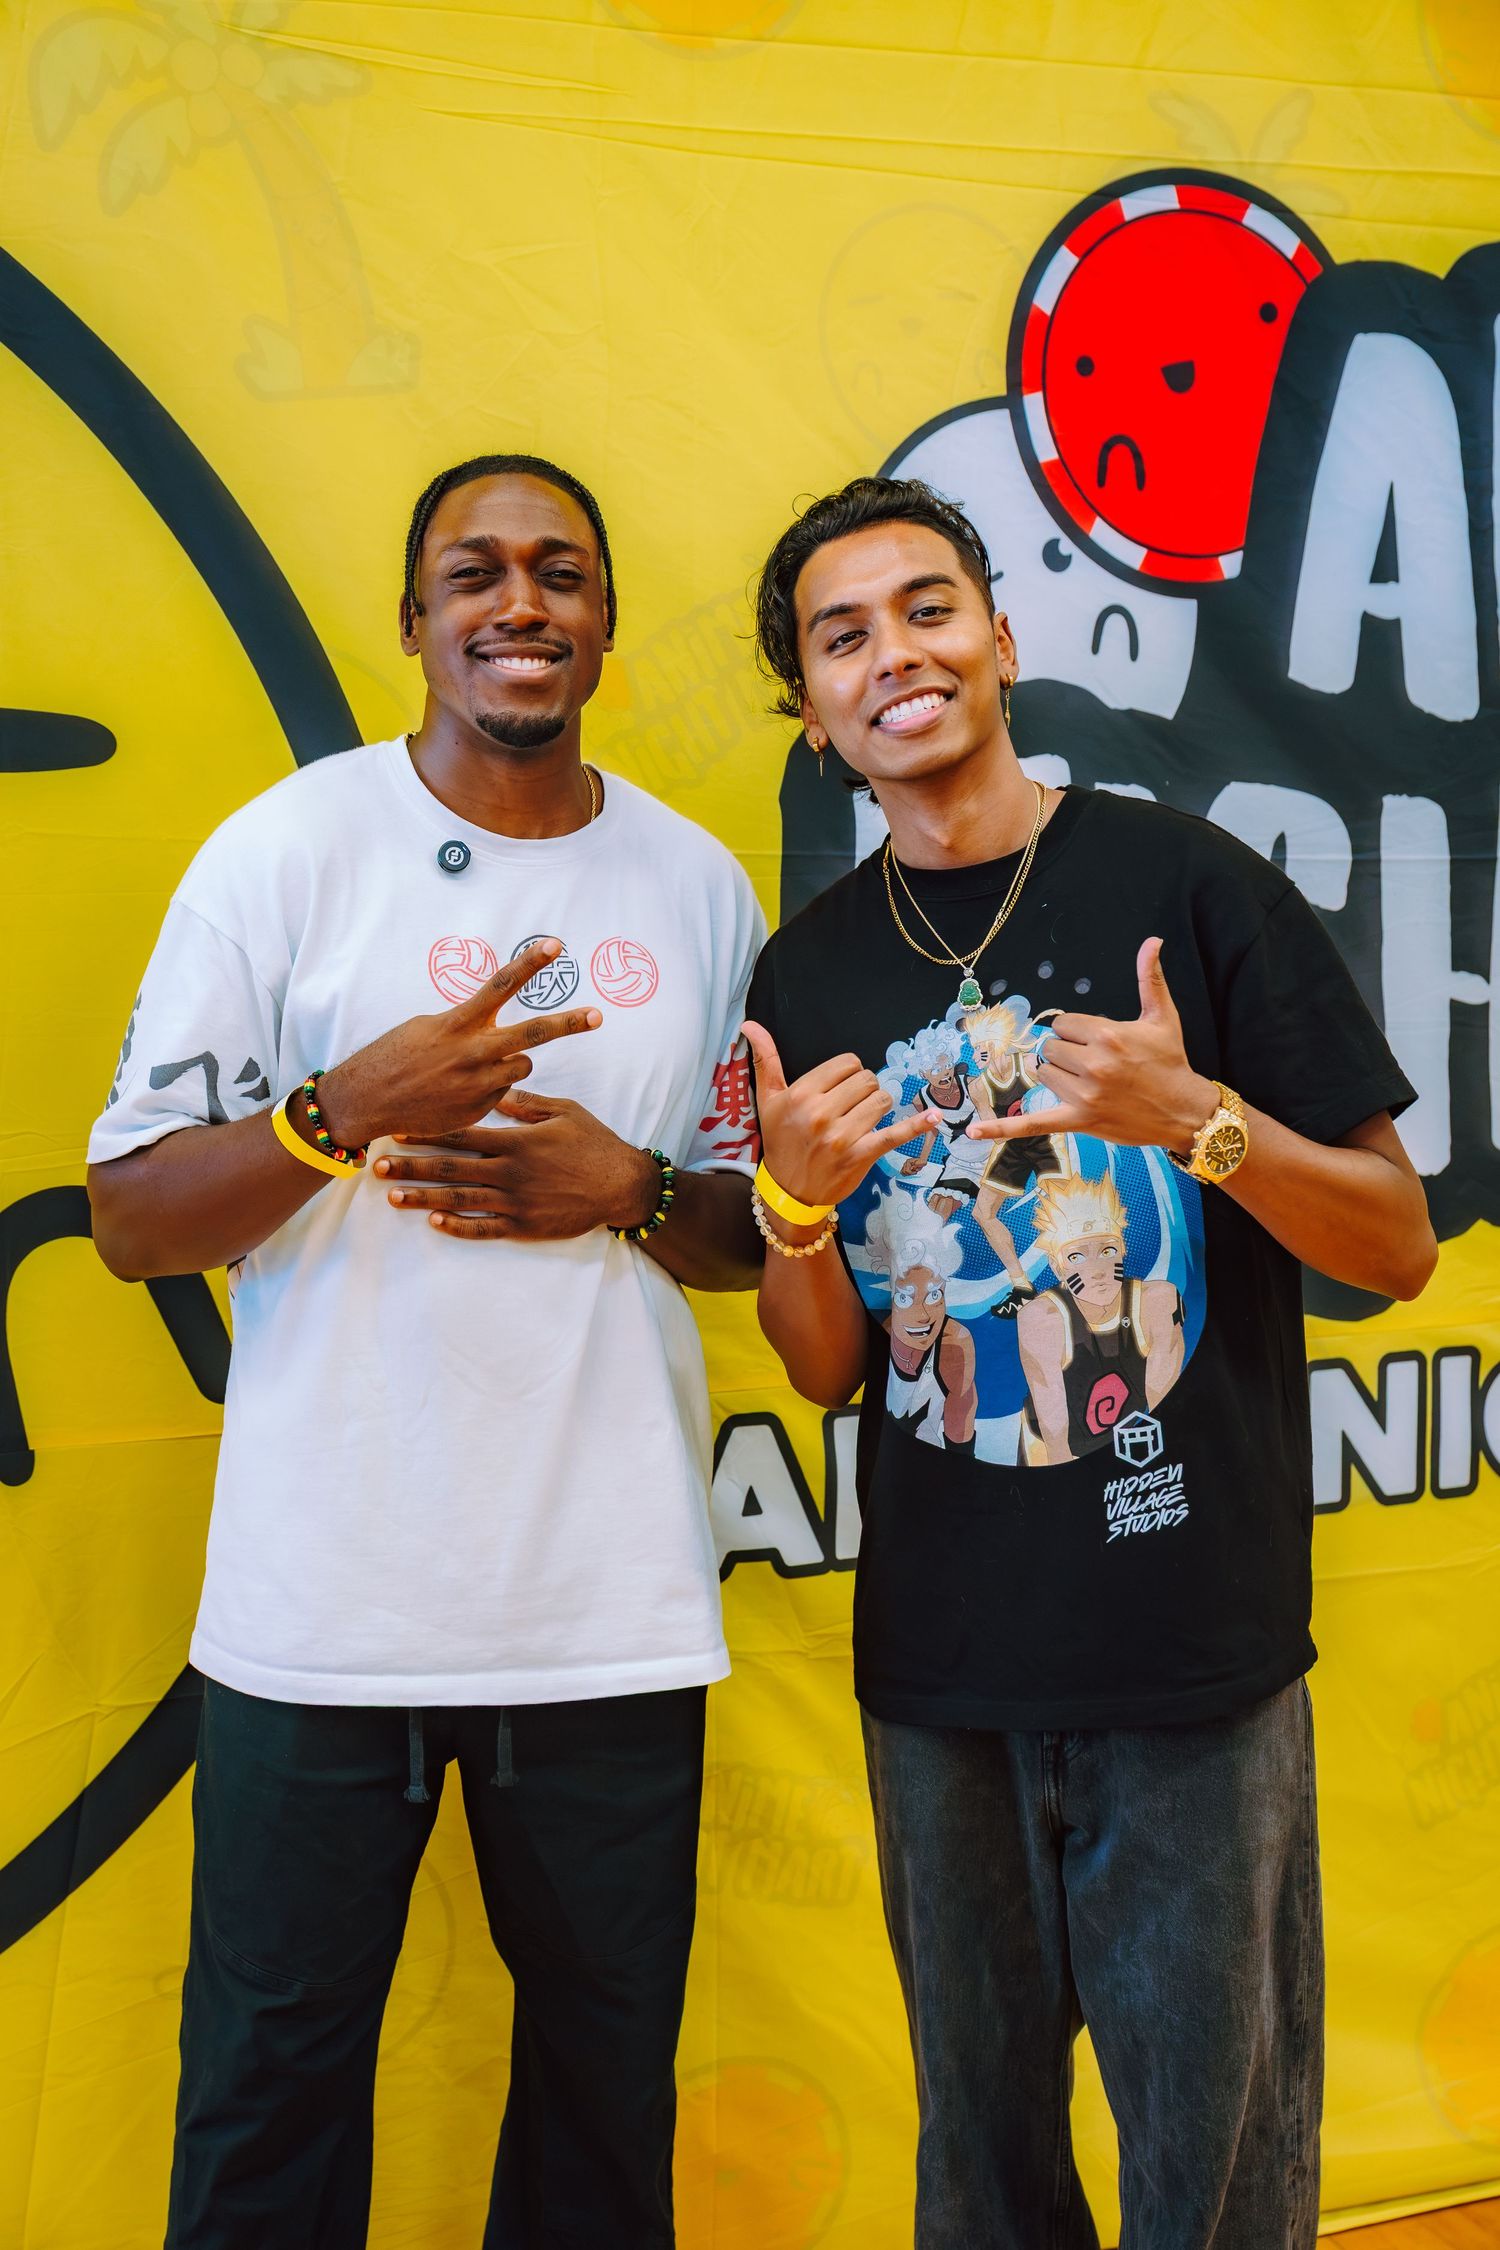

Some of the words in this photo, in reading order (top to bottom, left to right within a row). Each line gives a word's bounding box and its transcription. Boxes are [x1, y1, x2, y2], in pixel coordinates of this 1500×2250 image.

[1288, 314, 1500, 722] A
[1103, 1463, 1184, 1502] HIDDEN
[1106, 1483, 1187, 1521] VILLAGE
[1105, 1503, 1190, 1544] STUDIOS
